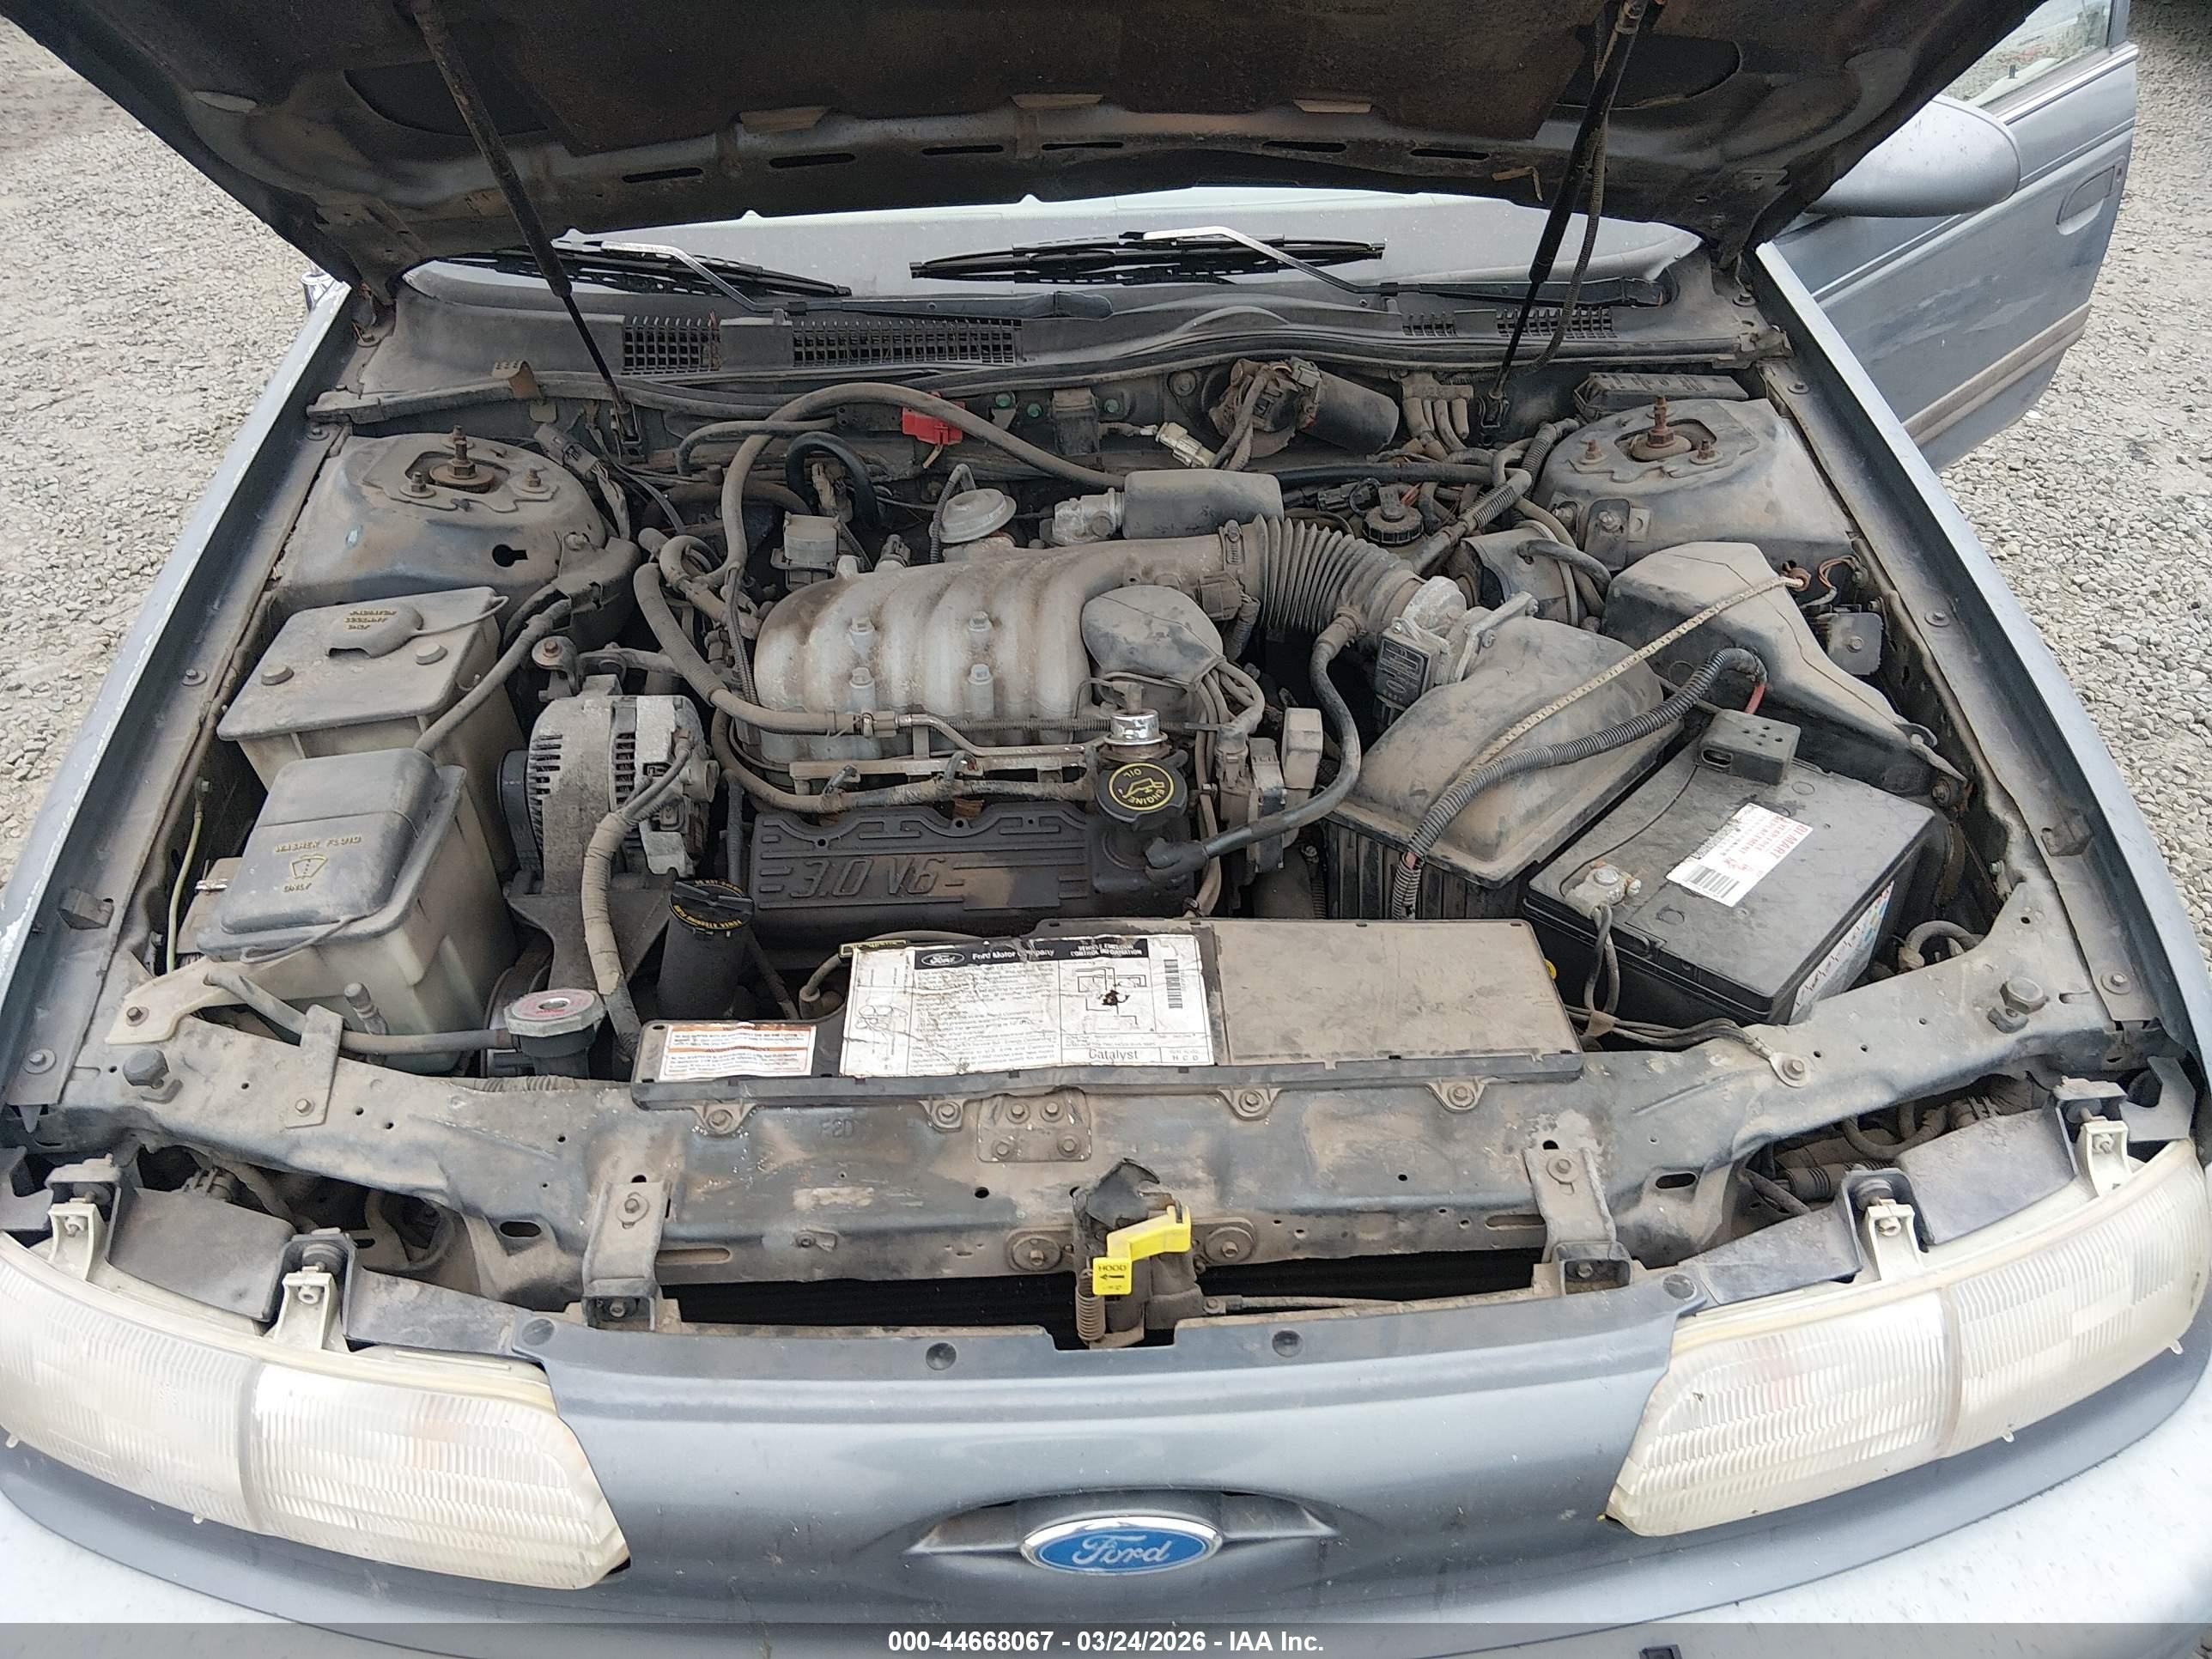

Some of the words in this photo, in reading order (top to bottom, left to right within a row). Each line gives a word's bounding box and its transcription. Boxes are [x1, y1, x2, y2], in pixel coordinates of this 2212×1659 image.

[1122, 768, 1142, 778] OIL
[1127, 788, 1165, 805] ENGINE
[789, 858, 874, 898] 3.0
[888, 856, 946, 895] V6
[972, 951, 991, 960] Ford
[1089, 1048, 1139, 1061] Catalyst
[1097, 1263, 1127, 1272] HOOD
[1072, 1534, 1173, 1565] Ford
